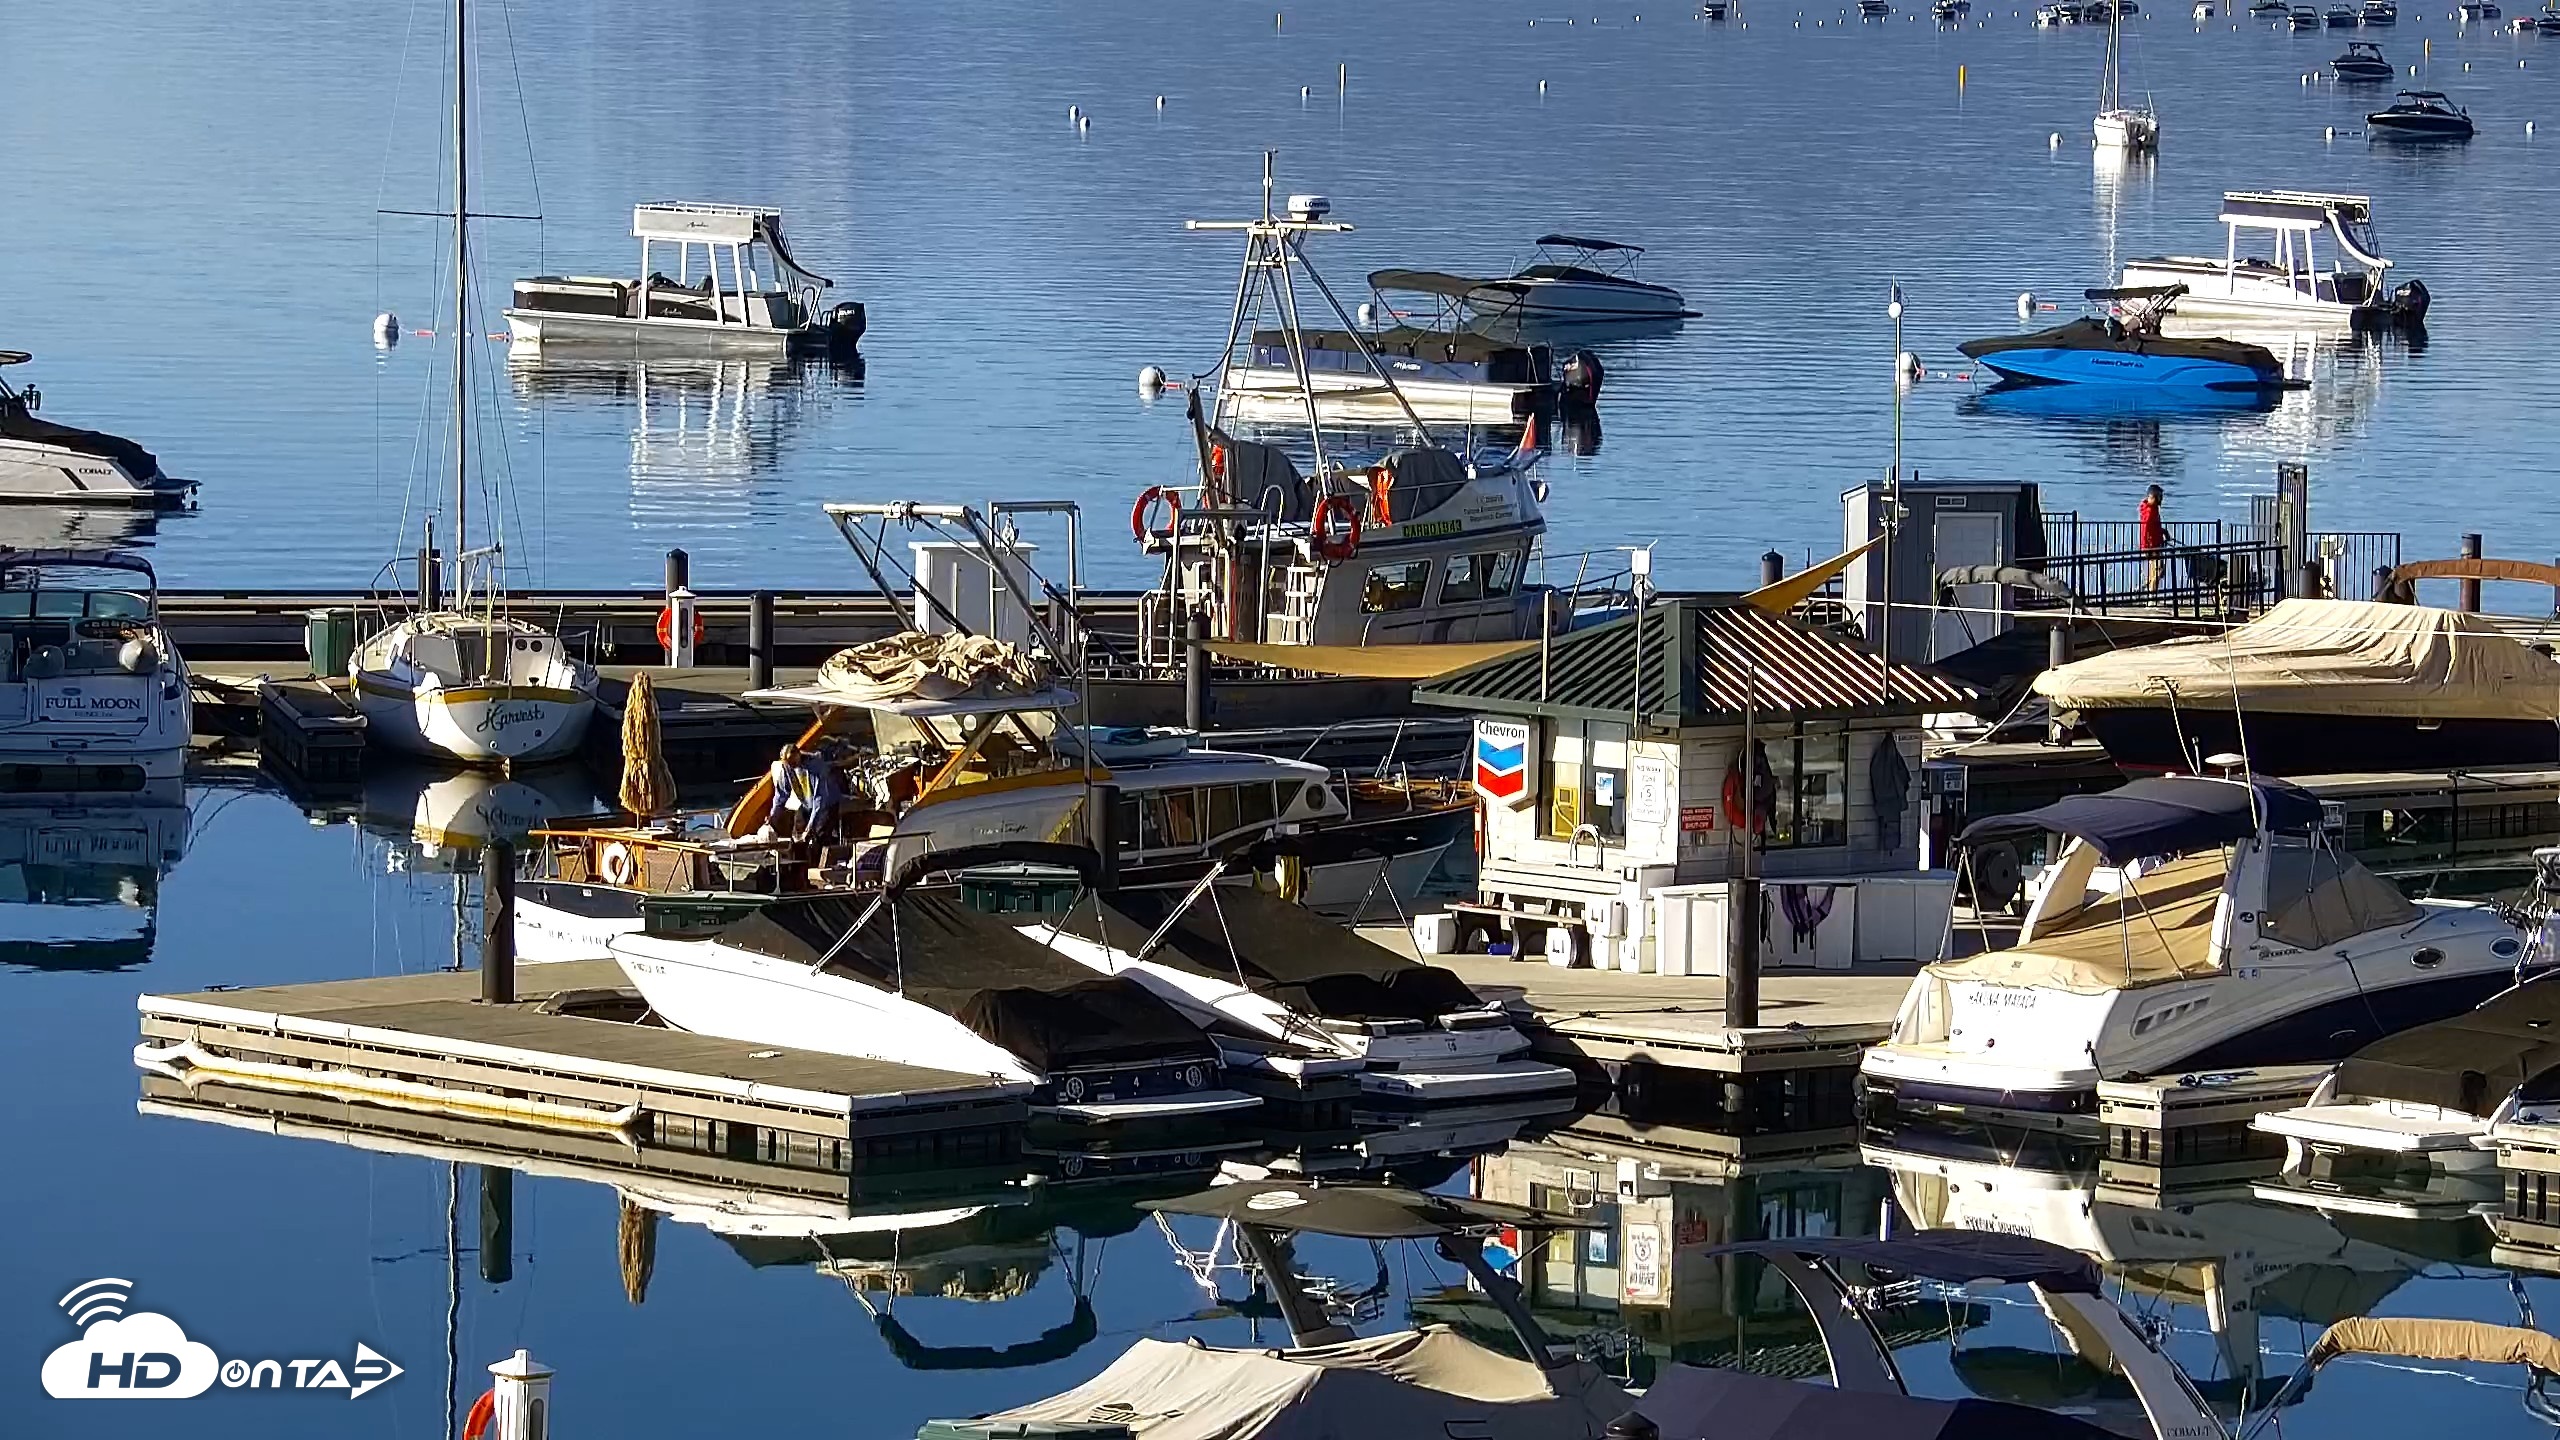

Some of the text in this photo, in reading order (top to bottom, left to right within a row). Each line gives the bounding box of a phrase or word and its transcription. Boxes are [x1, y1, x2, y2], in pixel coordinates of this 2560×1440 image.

[45, 698, 141, 710] FULL MOON
[476, 703, 545, 733] Harvest
[1478, 719, 1525, 739] Chevron
